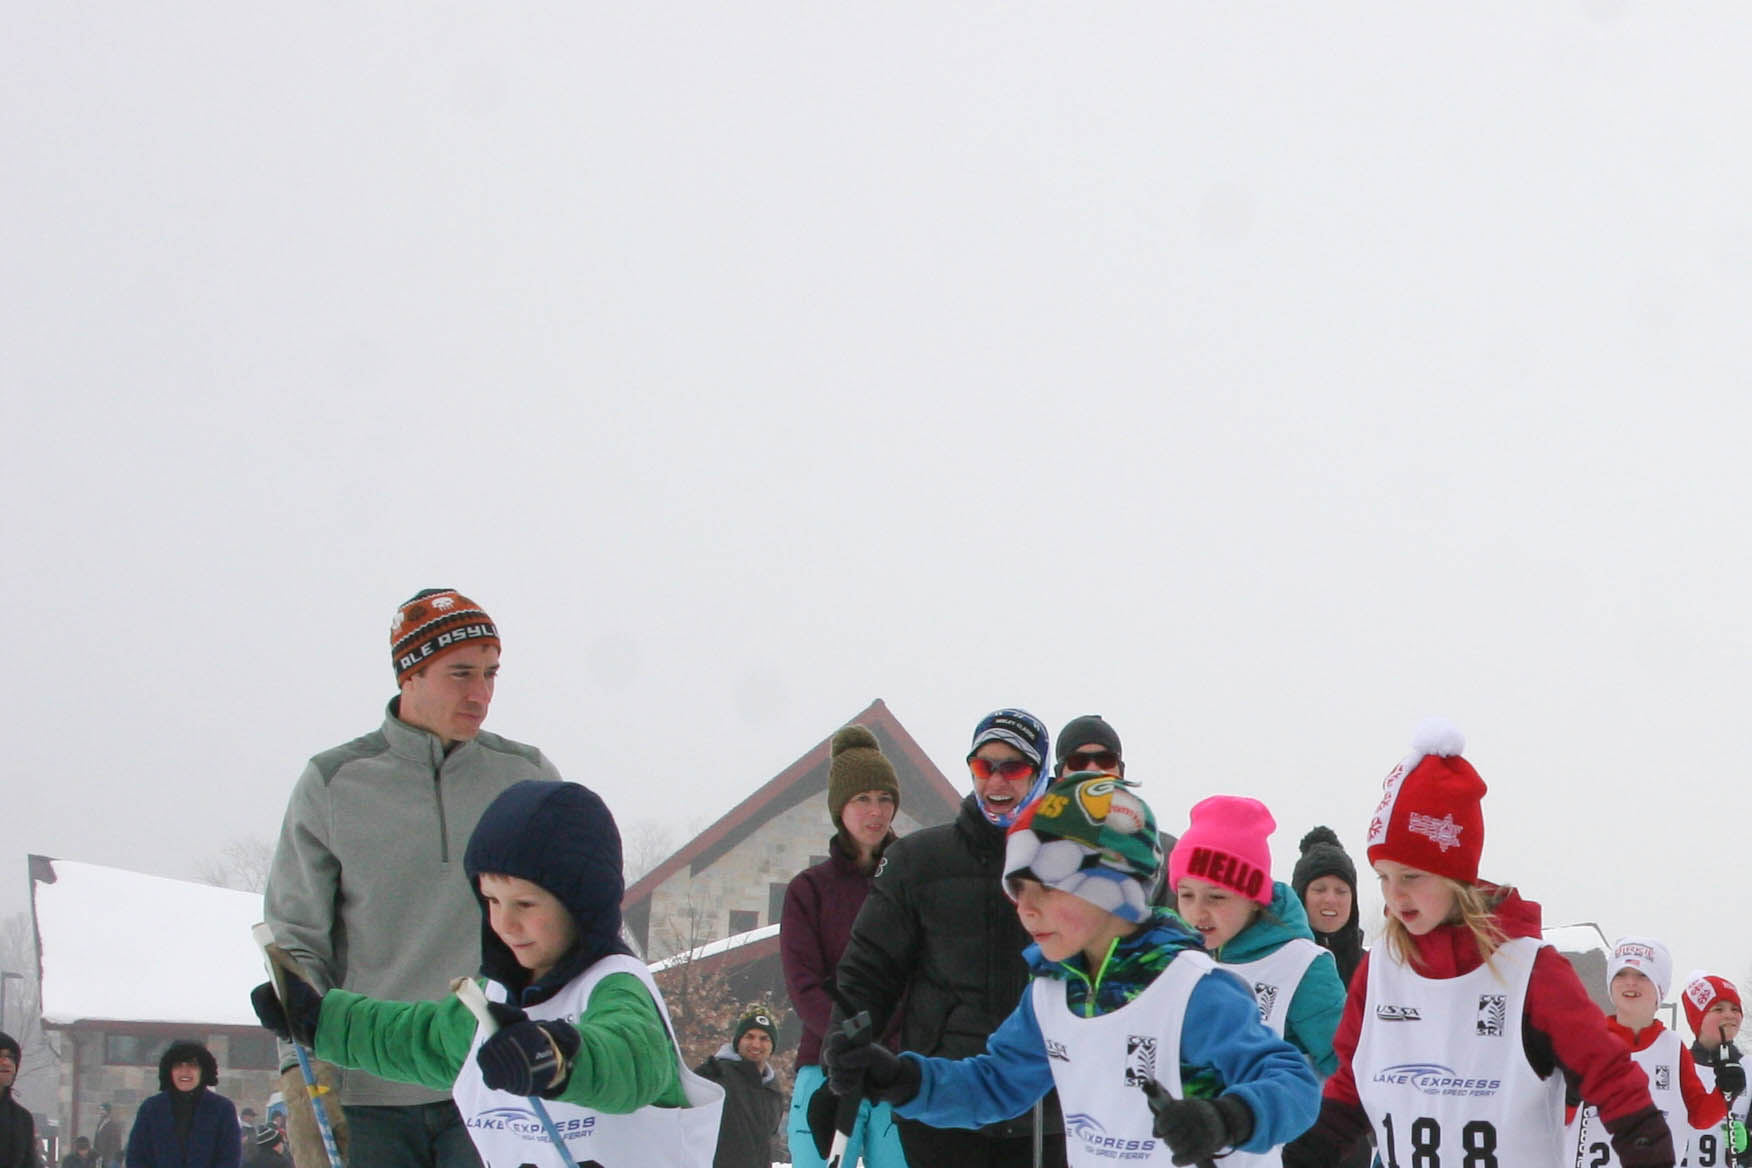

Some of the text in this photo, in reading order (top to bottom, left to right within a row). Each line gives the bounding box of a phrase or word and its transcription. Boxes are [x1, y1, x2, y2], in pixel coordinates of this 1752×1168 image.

[400, 642, 434, 669] ALE
[1187, 847, 1265, 898] HELLO
[1480, 994, 1507, 1003] CXC
[1376, 1004, 1420, 1017] USSA
[1127, 1035, 1157, 1048] CXC
[1373, 1074, 1501, 1090] LAKE EXPRESS
[467, 1117, 504, 1131] LAKE
